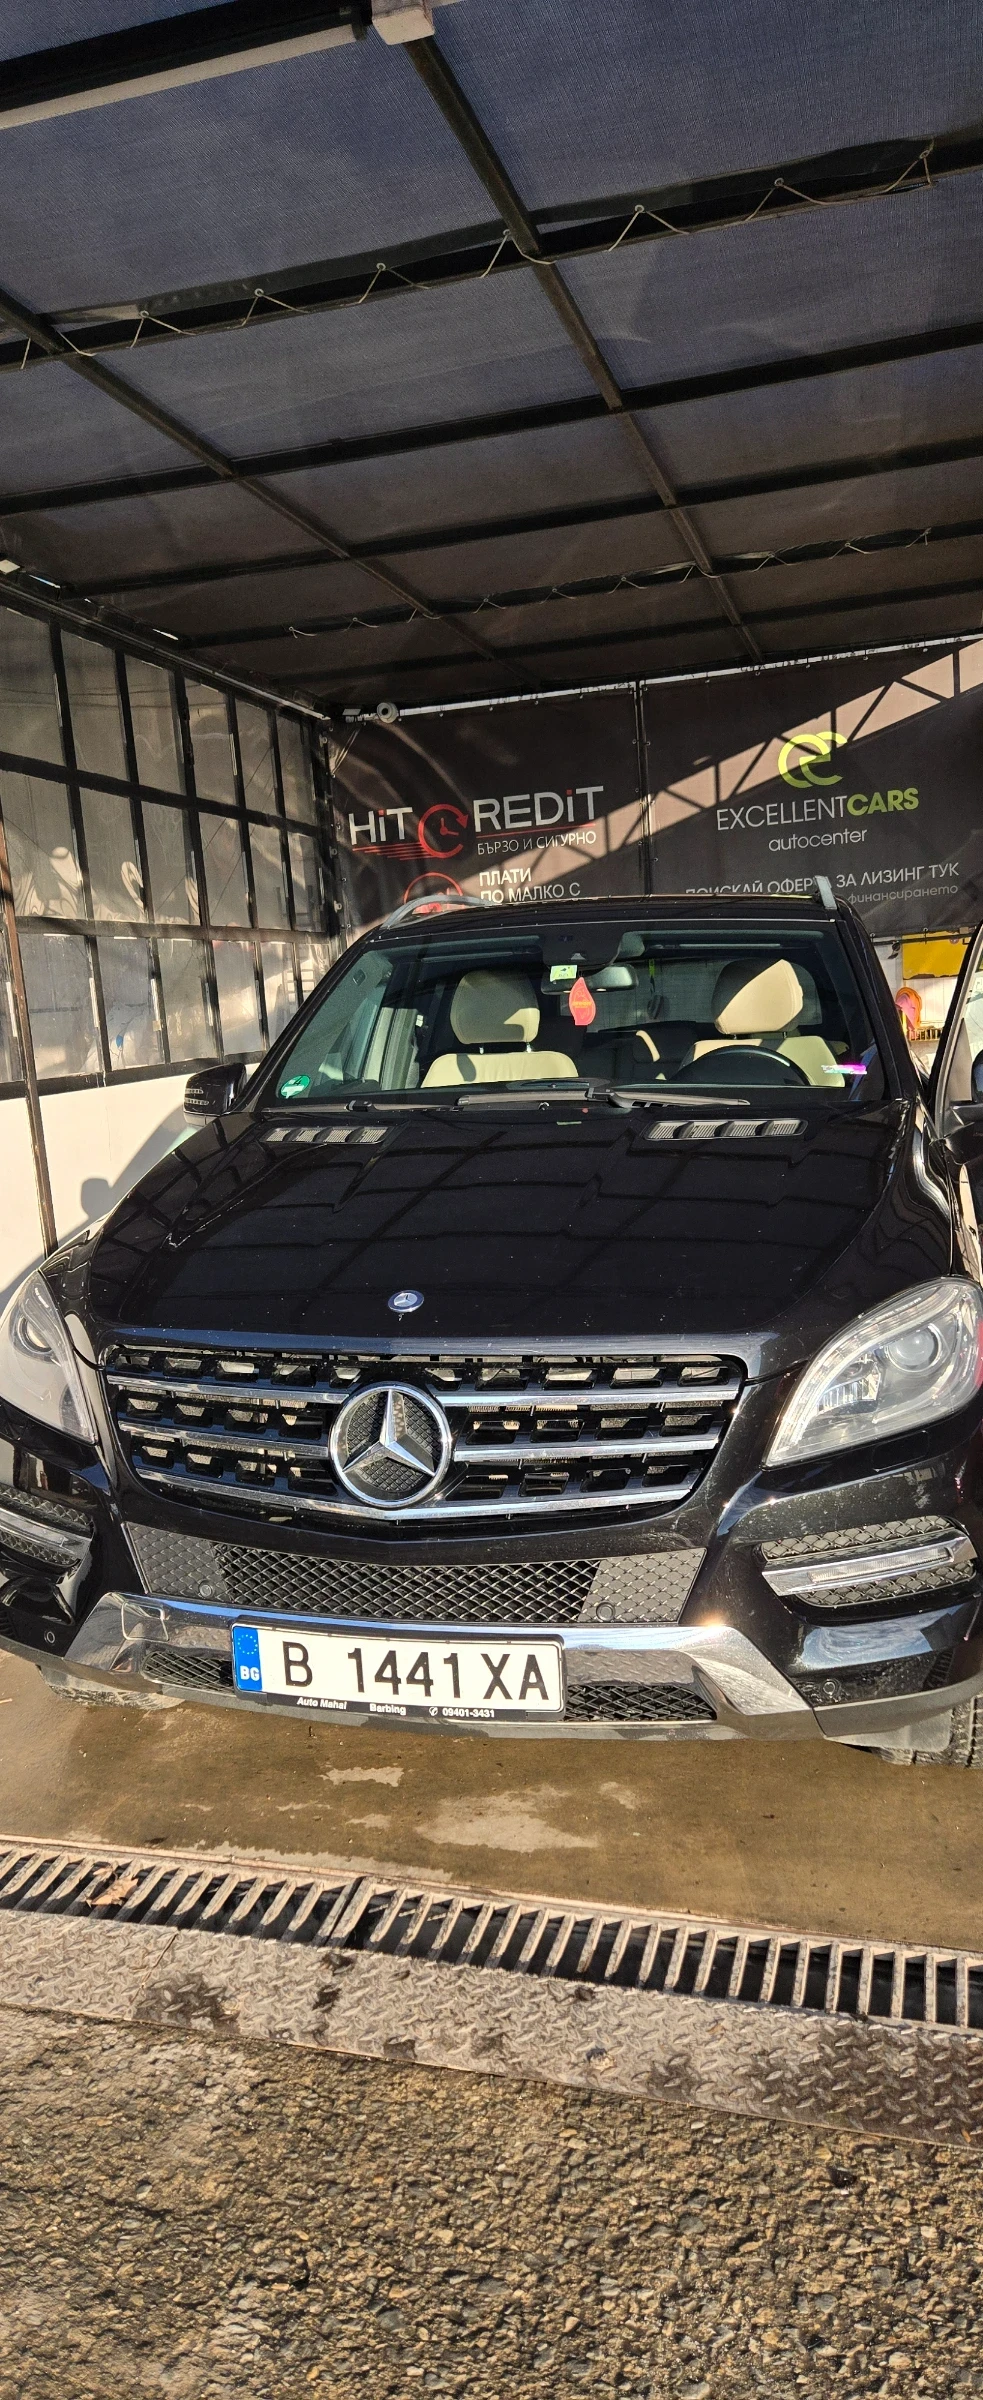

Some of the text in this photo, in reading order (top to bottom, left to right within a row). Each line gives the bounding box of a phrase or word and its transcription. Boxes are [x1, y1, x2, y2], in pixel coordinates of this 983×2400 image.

[477, 831, 597, 855] БЪРЗО И СИГУРНО
[768, 828, 868, 851] autocenter
[479, 867, 532, 887] ПЛАТИ
[767, 878, 814, 893] ОФЕР
[836, 873, 857, 888] ЗА
[860, 866, 925, 886] ЛИЗИНГ
[928, 862, 960, 879] ТУК
[480, 889, 504, 904] ПО
[508, 884, 564, 902] МАЛКО
[847, 884, 959, 905] финансирането
[240, 1664, 261, 1682] BG
[347, 1647, 461, 1699] 1441
[296, 1696, 319, 1707] Auto
[369, 1703, 407, 1716] Barbing
[442, 1707, 496, 1719] 09401-3431
